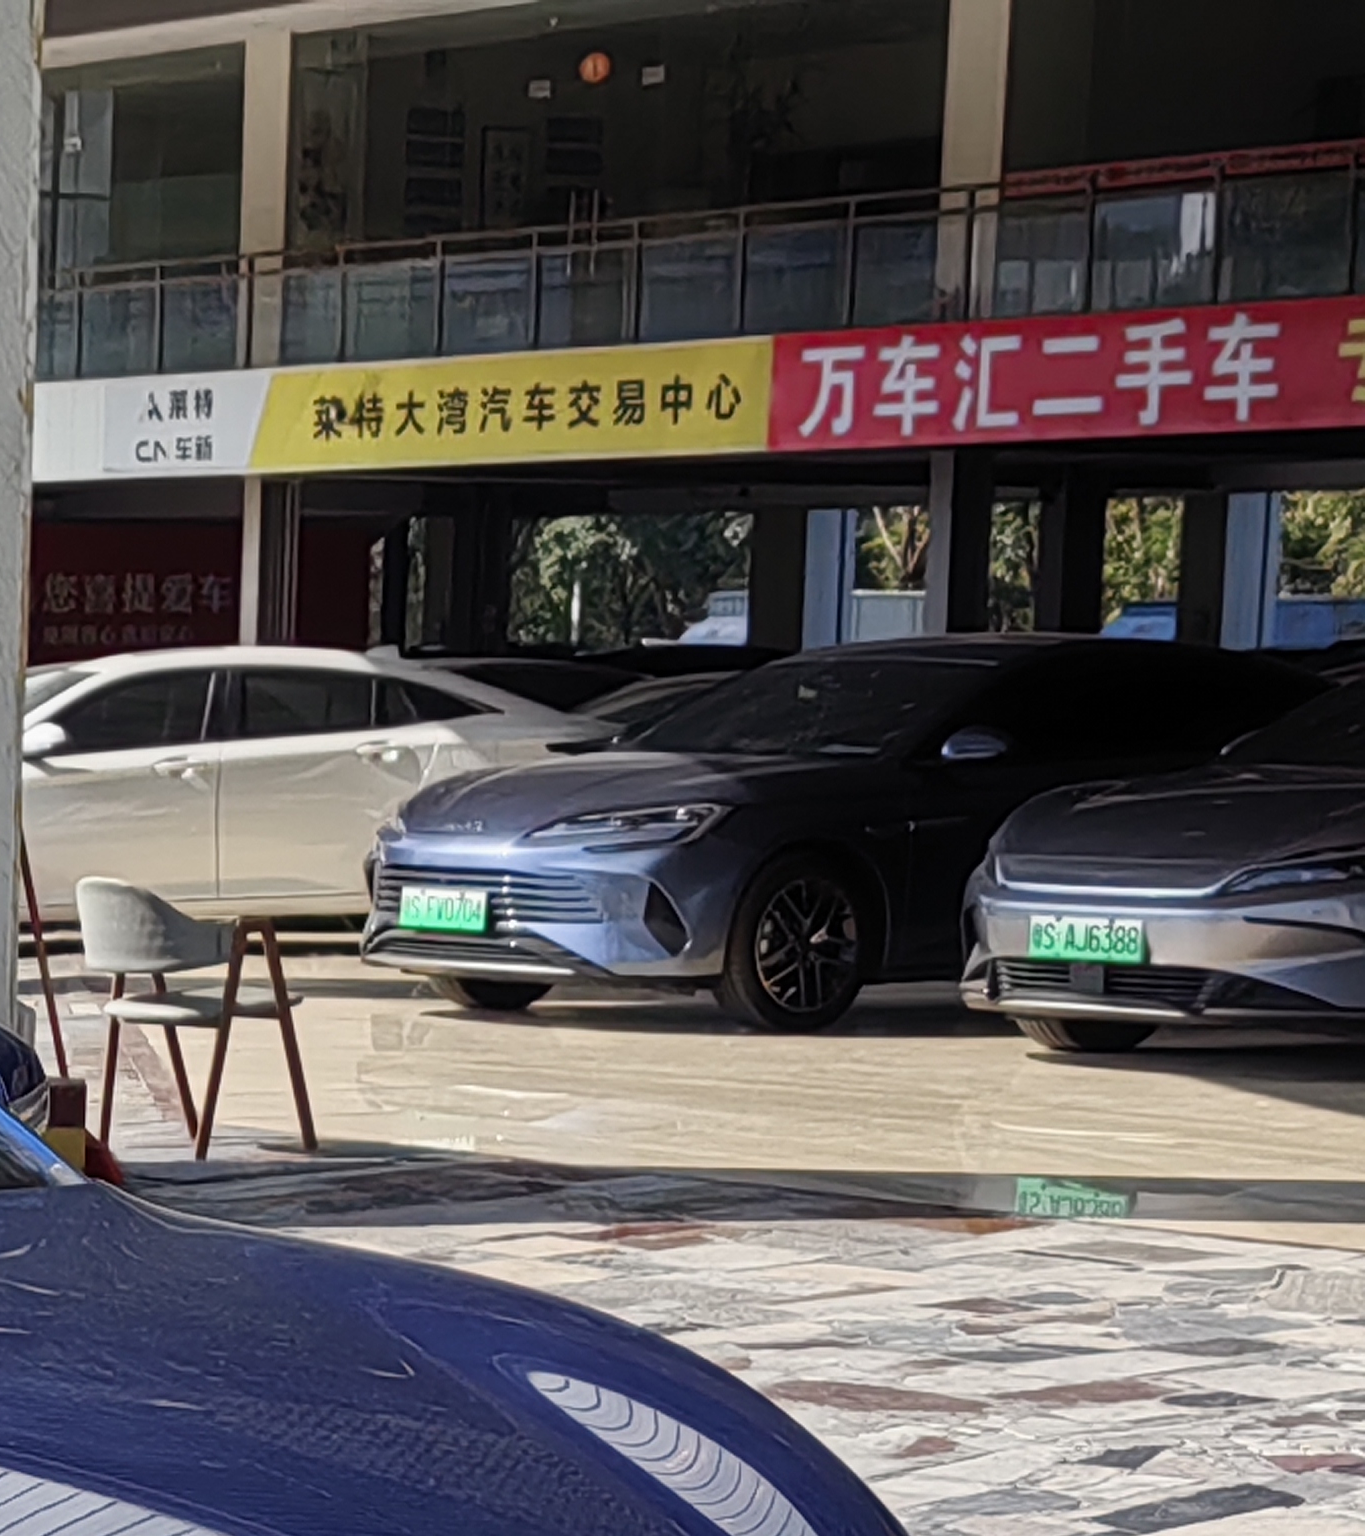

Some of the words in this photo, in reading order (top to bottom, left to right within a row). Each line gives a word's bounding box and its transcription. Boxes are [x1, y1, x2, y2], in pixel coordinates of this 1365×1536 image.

[798, 311, 1281, 438] 万车汇二手车
